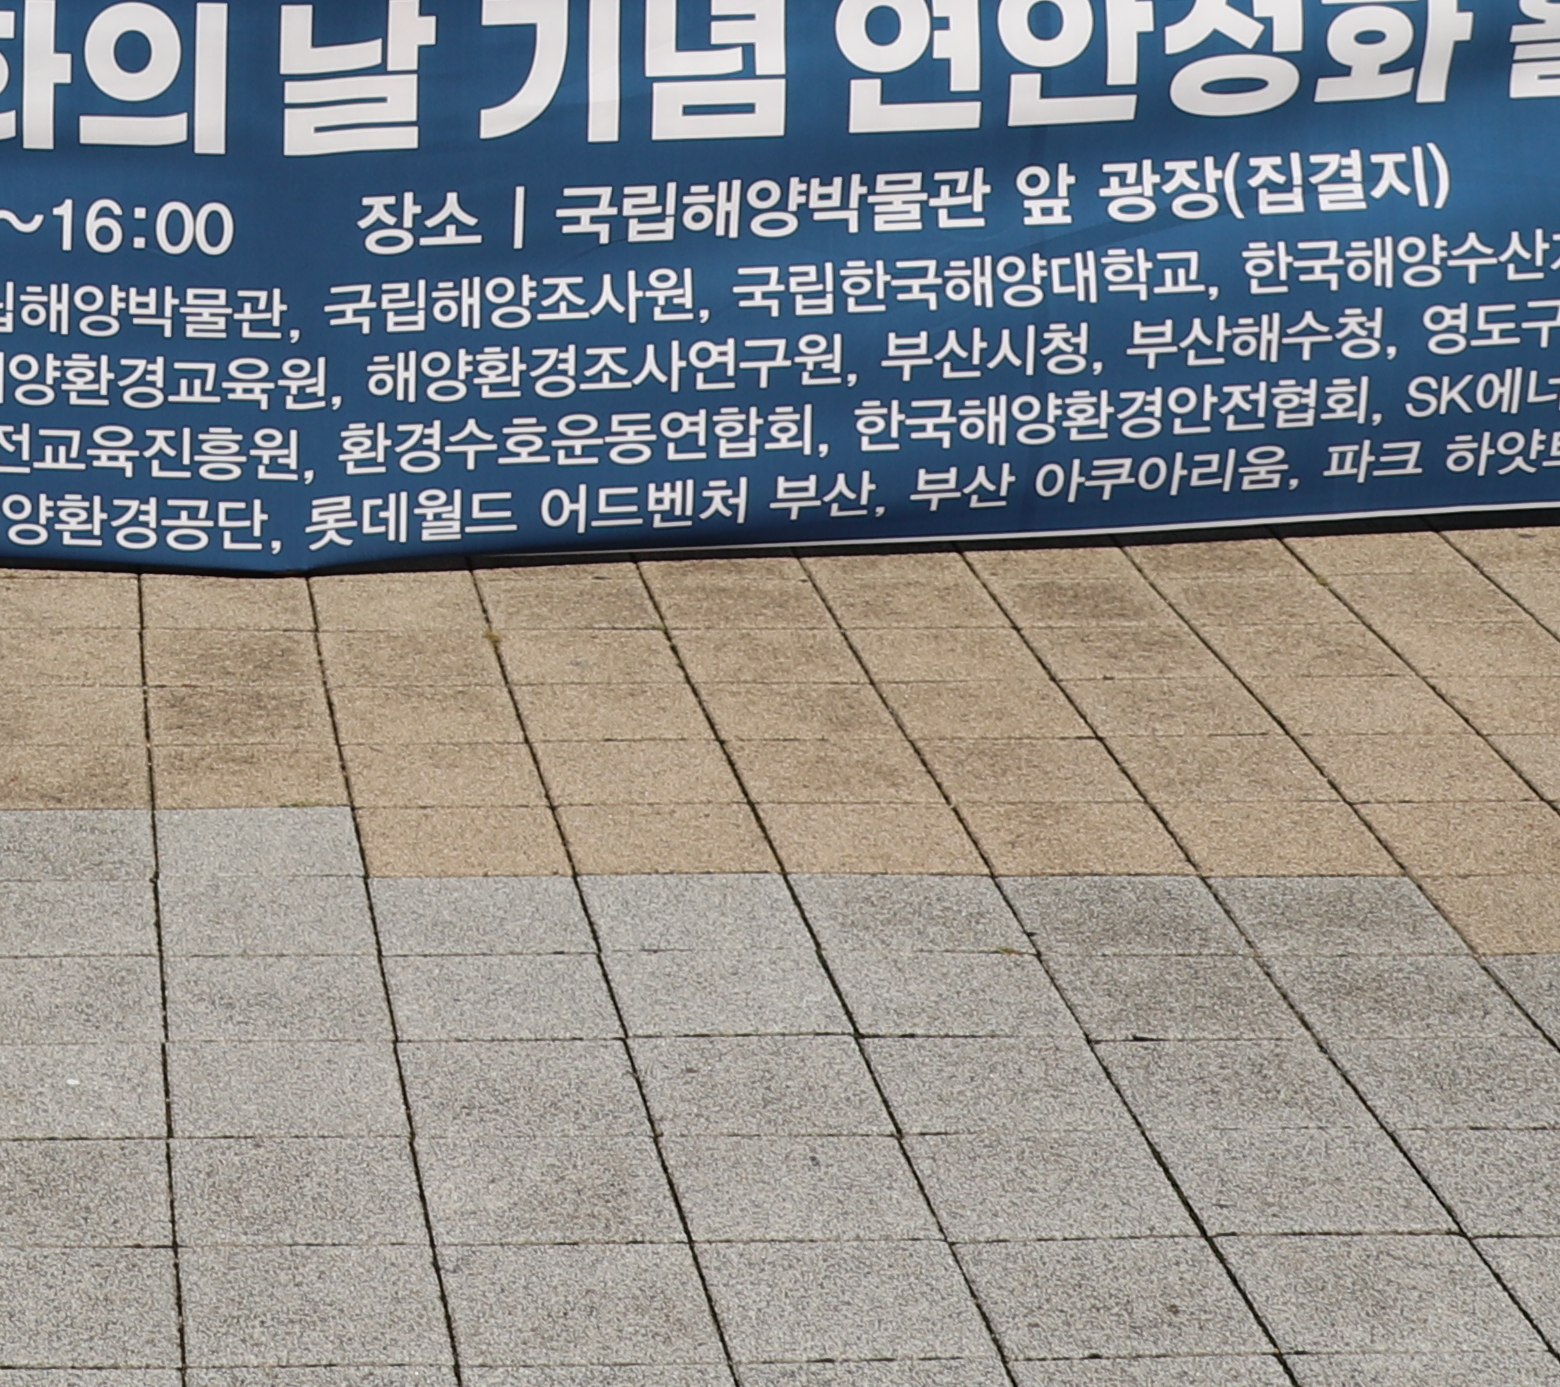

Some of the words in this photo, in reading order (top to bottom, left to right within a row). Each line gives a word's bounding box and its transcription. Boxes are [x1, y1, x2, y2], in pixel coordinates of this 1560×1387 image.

[356, 190, 482, 255] 장소
[556, 167, 990, 245] 국립해양박물관
[1015, 163, 1075, 226] 앞
[1098, 142, 1450, 223] 광장(집결지)
[323, 266, 710, 335] 국립해양조사원,
[733, 245, 1219, 318] 국립한국해양대학교,
[367, 333, 857, 404] 해양환경조사연구원,
[881, 322, 1104, 382] 부산시청,
[1126, 306, 1396, 370] 부산해수청,
[337, 404, 829, 477] 환경수호운동연합회,
[855, 376, 1383, 452] 한국해양환경안전협회,
[304, 488, 517, 550] 롯데월드
[540, 477, 748, 533] 어드벤처
[769, 470, 885, 520] 부산,
[909, 462, 1015, 511] 부산
[1034, 446, 1299, 503] 아쿠아리움,
[1321, 438, 1424, 482] 파크
